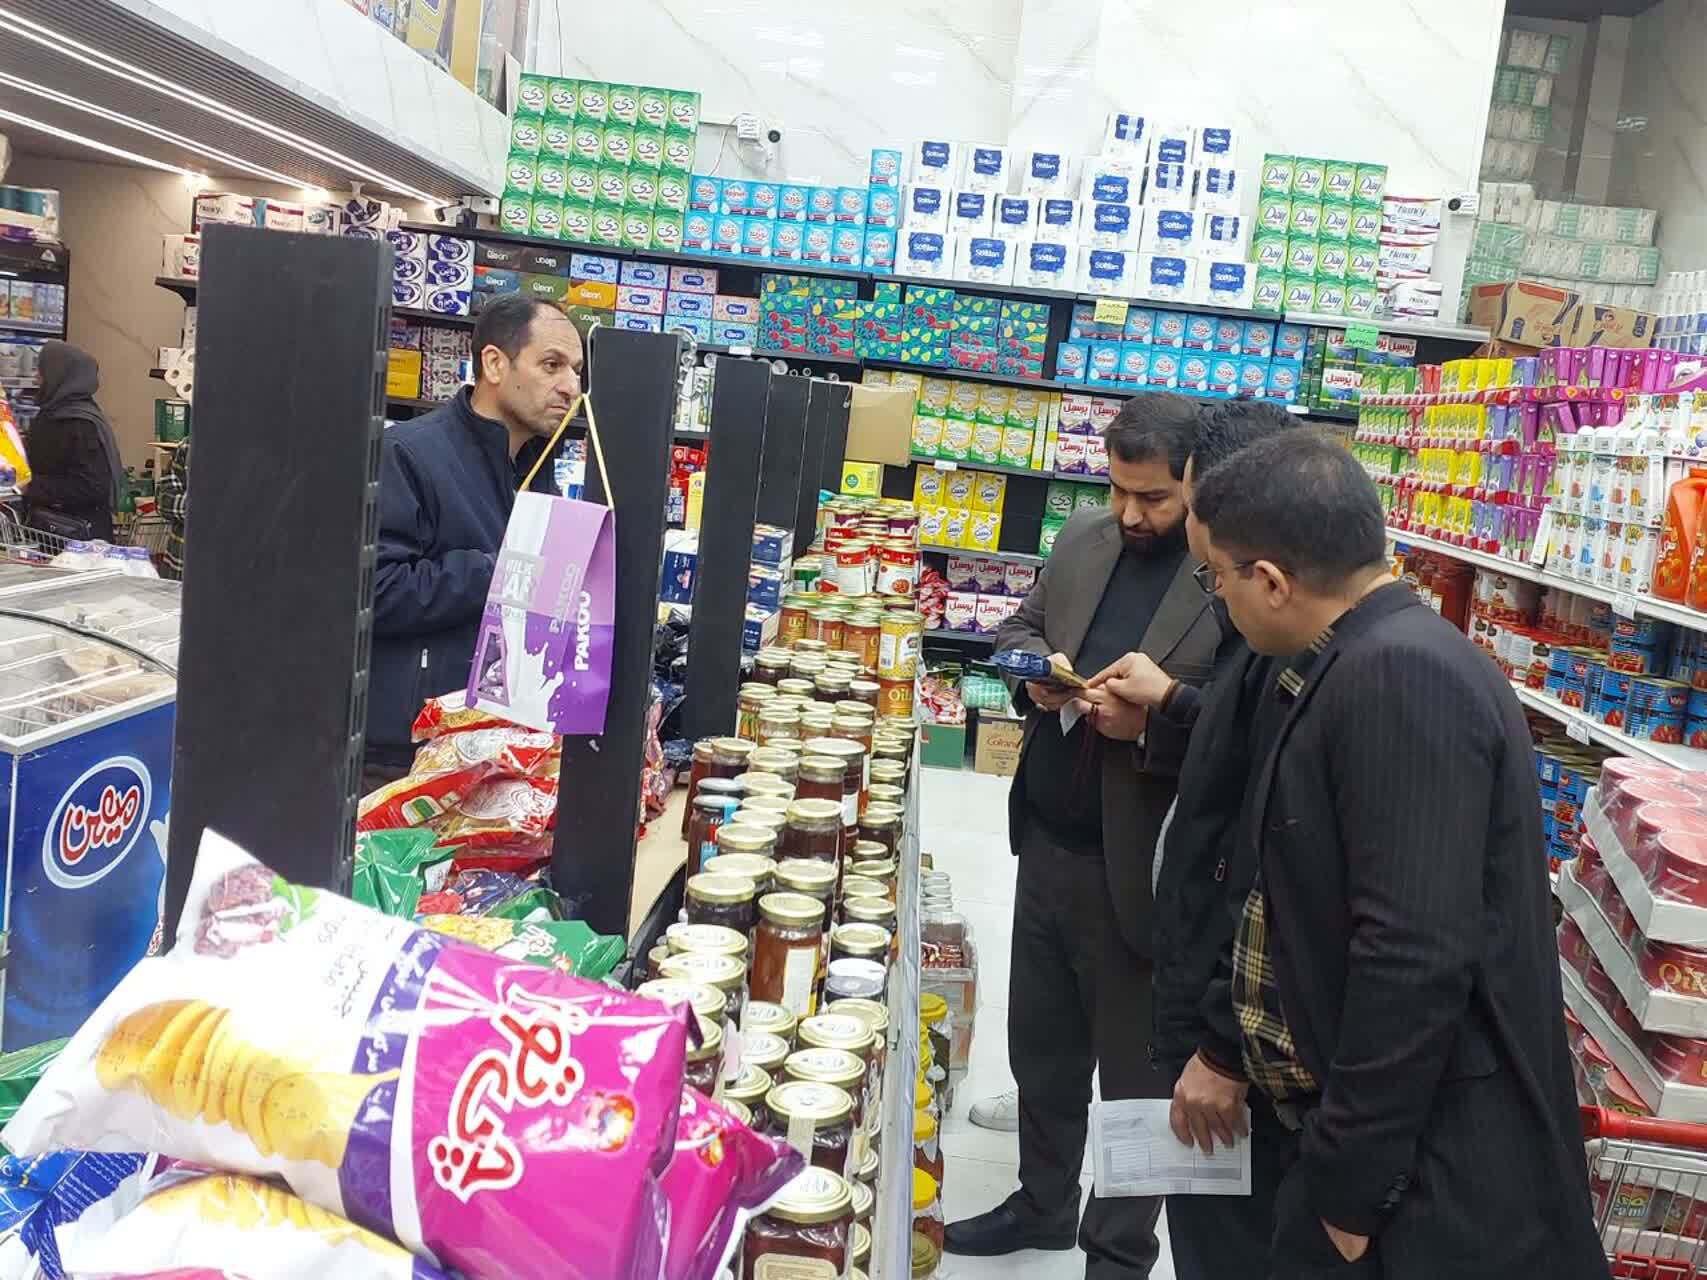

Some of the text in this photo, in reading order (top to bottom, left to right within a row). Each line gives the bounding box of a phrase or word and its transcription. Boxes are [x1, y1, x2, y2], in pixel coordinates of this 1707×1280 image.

[1266, 167, 1288, 185] Day
[1297, 171, 1320, 187] Day
[1329, 174, 1351, 190] Day
[1359, 177, 1381, 193] Day
[1264, 207, 1286, 223] Day
[1294, 210, 1317, 225] Day
[1325, 213, 1347, 230] Day
[1355, 217, 1377, 232] Day
[1260, 246, 1283, 262] Day
[1292, 249, 1314, 265] Day
[1323, 253, 1345, 268] Day
[1352, 255, 1374, 271] Day
[1257, 285, 1280, 301] Day
[1288, 287, 1311, 304] Day
[1319, 291, 1341, 307] Day
[1350, 295, 1372, 311] Day
[60, 785, 140, 865] میهن
